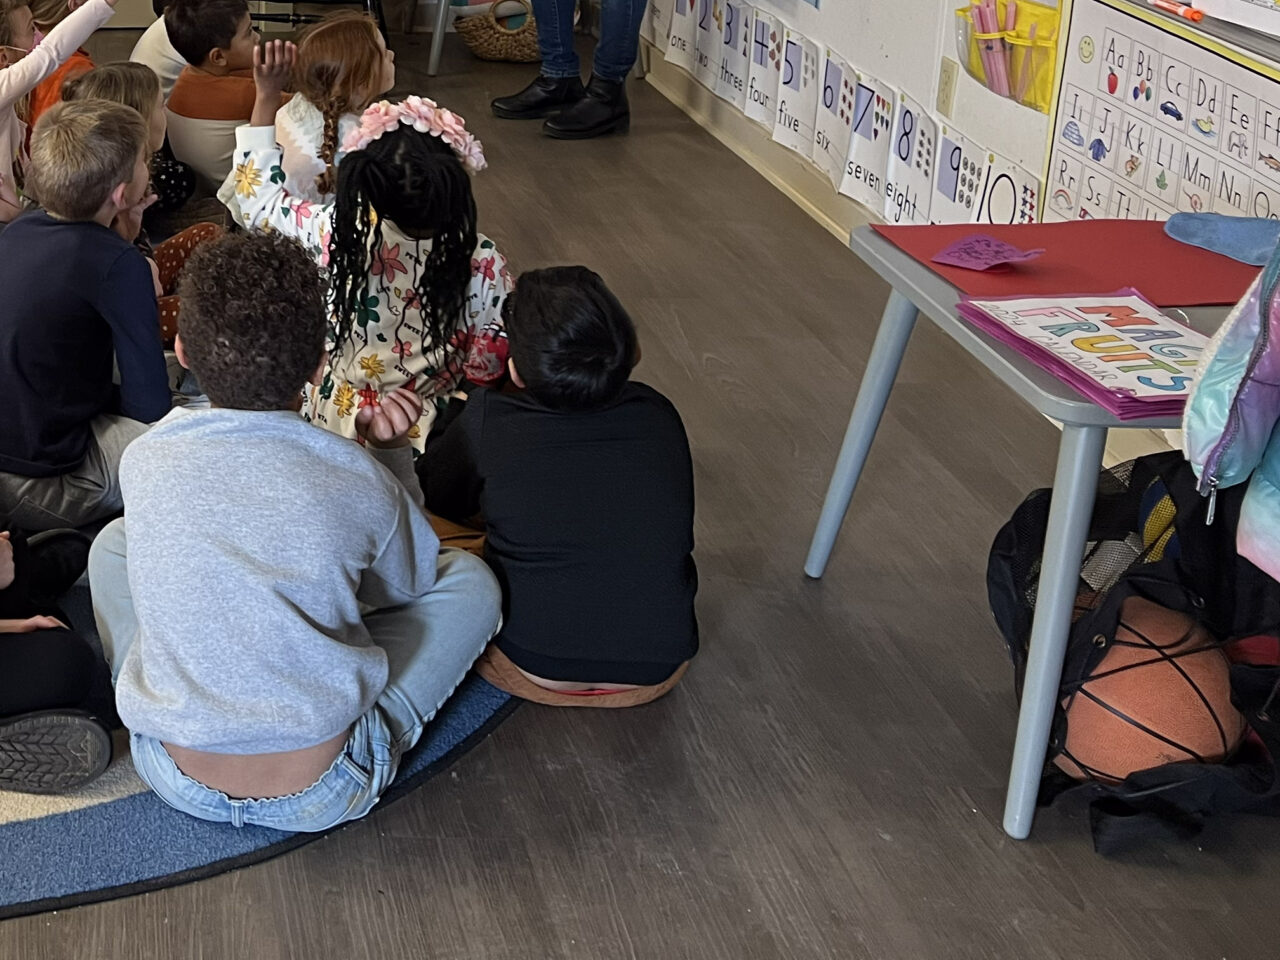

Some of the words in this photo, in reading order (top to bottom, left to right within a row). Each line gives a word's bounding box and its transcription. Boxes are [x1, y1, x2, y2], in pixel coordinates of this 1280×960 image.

[724, 2, 734, 46] 3
[754, 16, 769, 66] 4
[721, 57, 744, 94] three
[783, 39, 802, 85] 5
[823, 57, 834, 109] 6
[1106, 38, 1124, 68] Aa
[1137, 50, 1153, 82] Bb
[1166, 65, 1182, 97] Cc
[1197, 78, 1216, 114] Dd
[1231, 94, 1250, 130] Ee
[749, 77, 769, 107] four
[854, 82, 875, 133] 7
[777, 101, 799, 134] five
[898, 109, 913, 161] 8
[816, 130, 830, 152] six
[1072, 94, 1082, 122] Ii
[1100, 108, 1116, 153] Jj
[1126, 120, 1144, 156] Kk
[1185, 152, 1211, 190] Mm
[1219, 171, 1242, 208] Nn
[847, 159, 880, 192] seven
[950, 146, 961, 202] 9
[977, 164, 1016, 223] 10
[1058, 160, 1076, 187] Rr
[1086, 176, 1102, 206] Ss
[886, 180, 917, 222] eight
[981, 302, 1025, 327] 2024
[1014, 306, 1194, 392] FRUITS
[1028, 335, 1118, 382] CALENDAR
